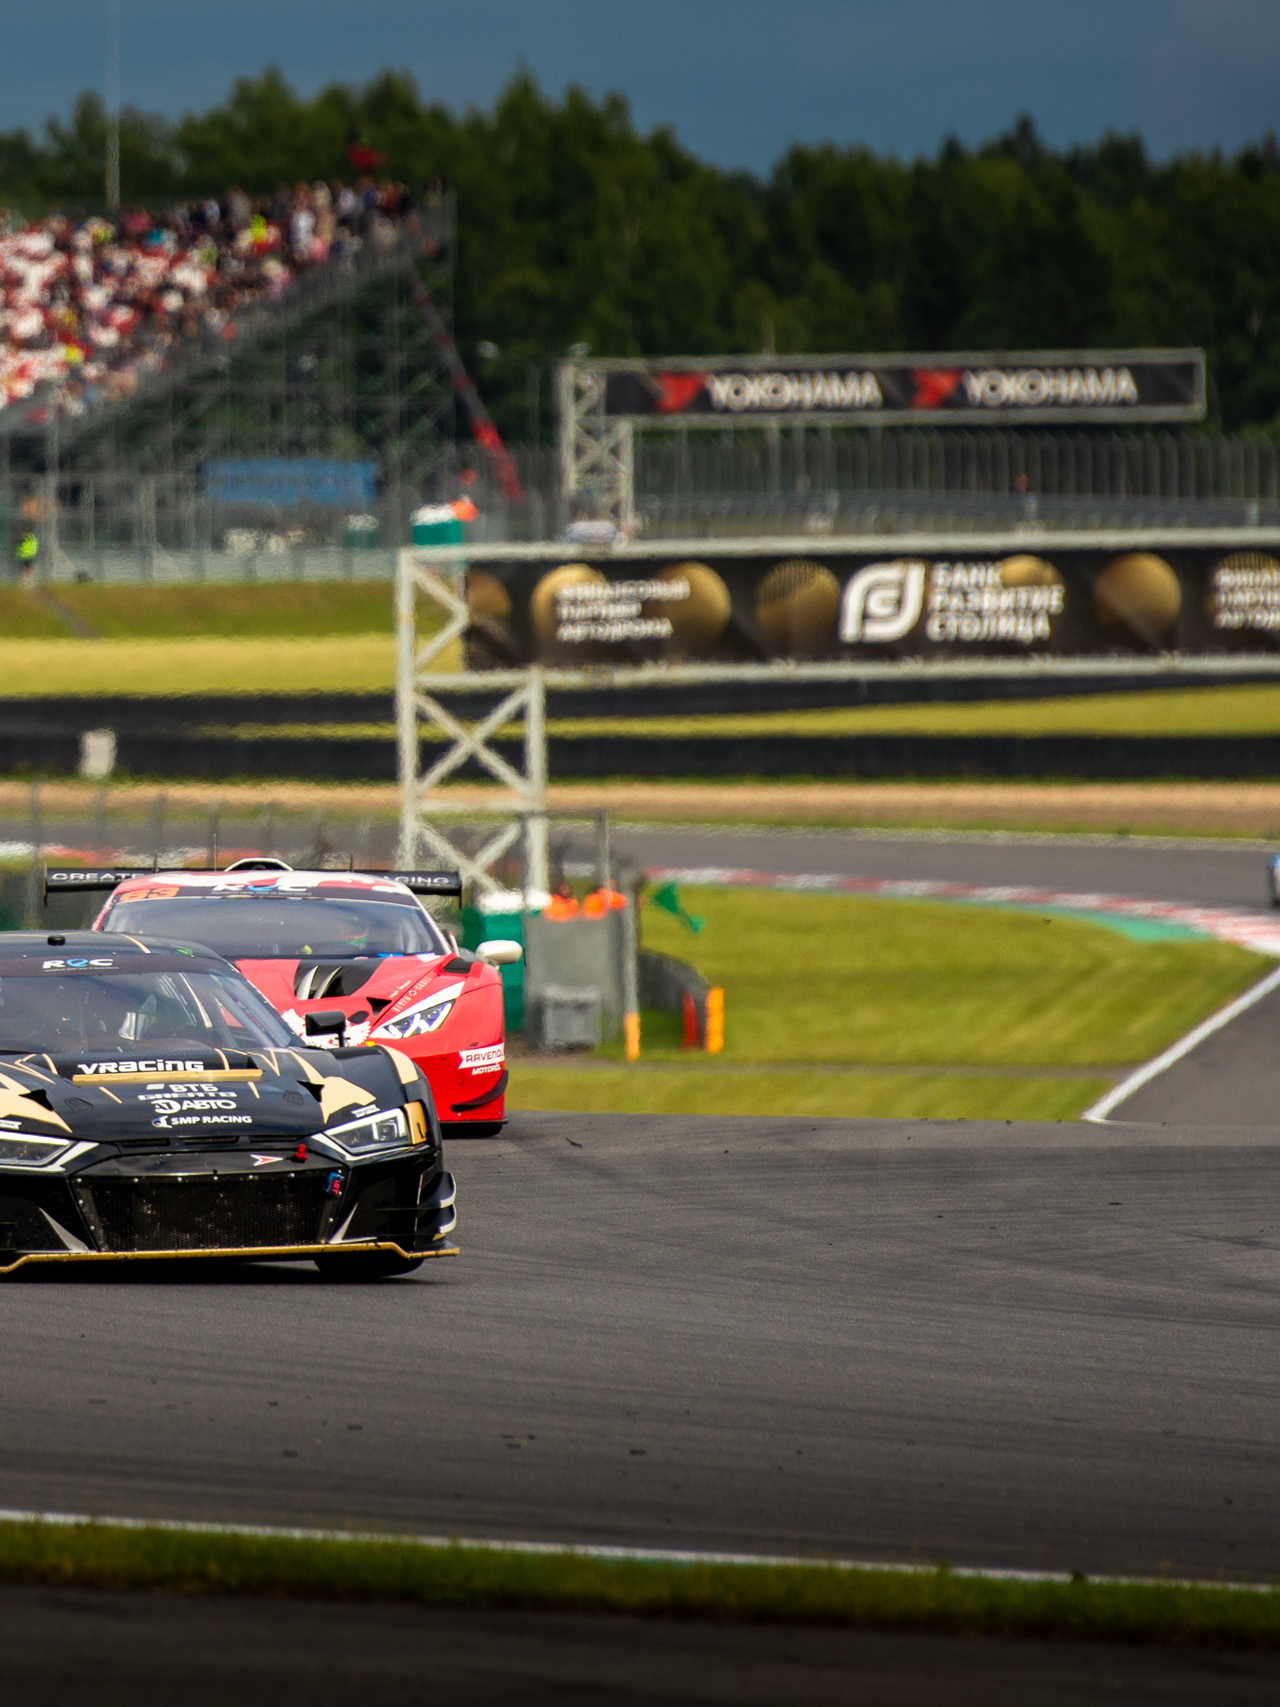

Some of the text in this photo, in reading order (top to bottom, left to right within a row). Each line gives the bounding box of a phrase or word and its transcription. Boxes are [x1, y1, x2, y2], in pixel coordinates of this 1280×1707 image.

[706, 371, 883, 410] YOKOHAMA
[962, 367, 1138, 407] YOKOHAMA
[926, 610, 1051, 645] СТОЛИЦА
[171, 1115, 252, 1125] SMP RACING
